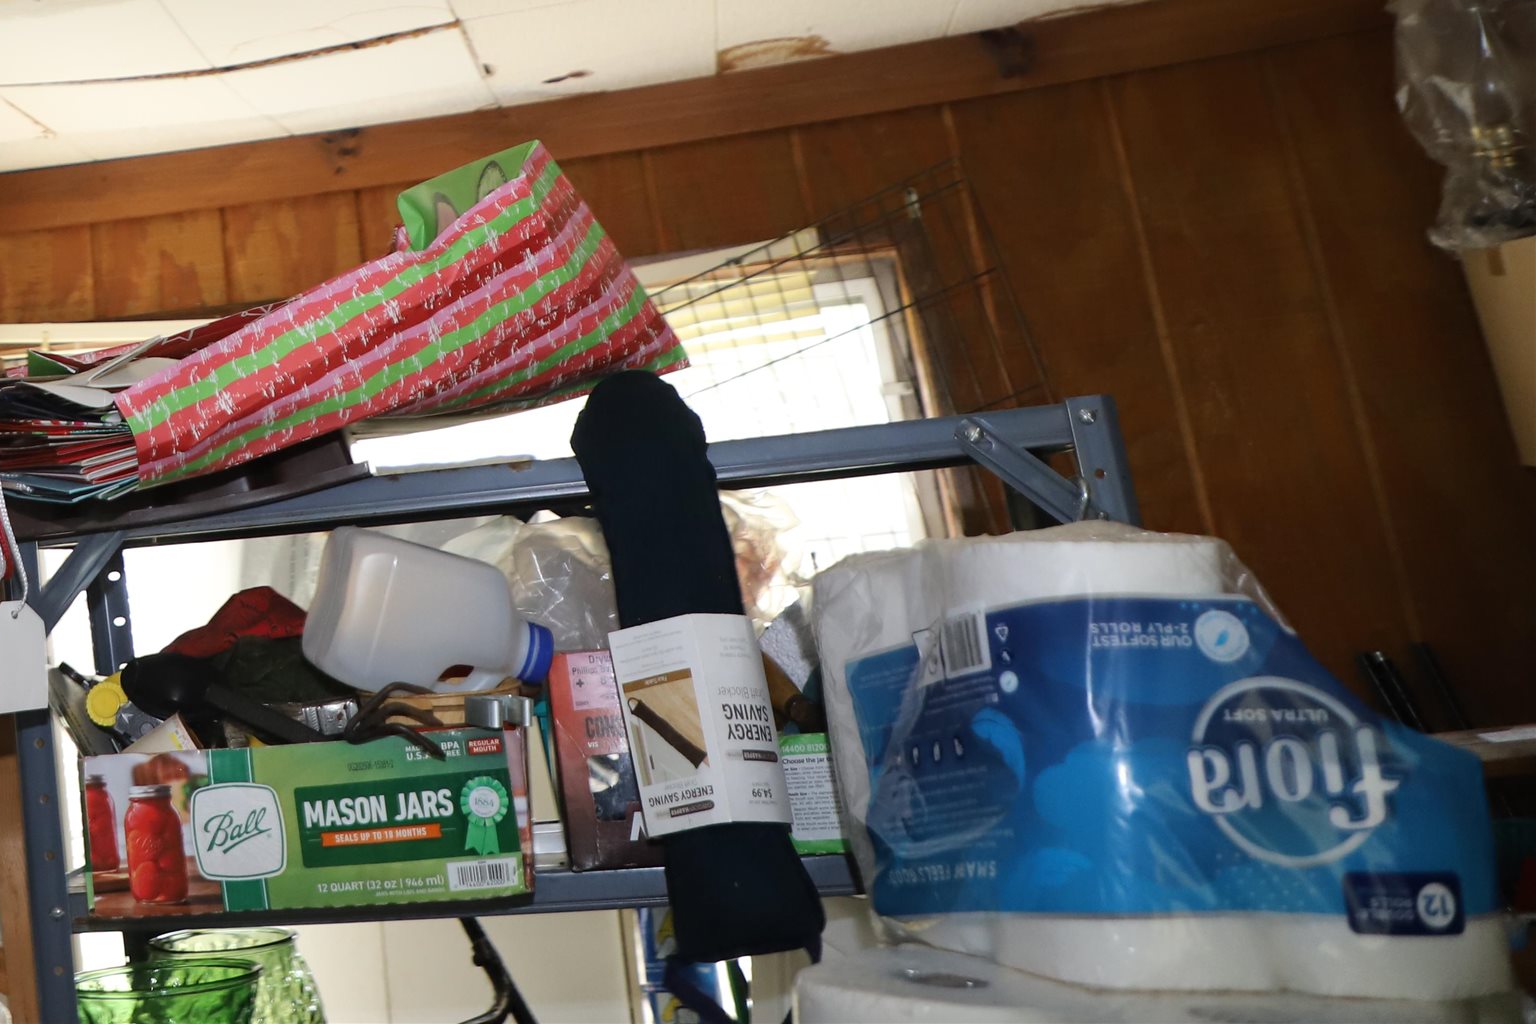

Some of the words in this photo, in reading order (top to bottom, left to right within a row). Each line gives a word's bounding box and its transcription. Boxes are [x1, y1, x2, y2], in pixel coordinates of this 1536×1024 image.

[1089, 622, 1141, 634] ROLLS
[1147, 622, 1188, 634] 2-PLY
[1092, 634, 1158, 647] SOFTEST
[1162, 634, 1193, 647] OUR
[716, 686, 750, 699] Blocker
[722, 703, 769, 721] SAVING
[1222, 708, 1267, 721] SOFT
[1271, 707, 1330, 722] ULTRA
[727, 723, 773, 742] ENERGY
[440, 741, 460, 751] BPA
[468, 738, 500, 747] REGULAR
[473, 745, 497, 753] MOUTH
[1186, 726, 1401, 830] fiora
[680, 785, 714, 798] ENERGY
[751, 787, 773, 798] $4.99
[648, 791, 680, 807] SAVING
[303, 793, 388, 829] MASON
[394, 788, 454, 820] JARS
[203, 806, 272, 855] Ball
[334, 832, 359, 843] SEALS
[360, 831, 370, 841] UP
[373, 831, 382, 840] TO
[395, 826, 427, 838] MONTHS
[317, 883, 328, 893] 12
[330, 880, 365, 892] QUART
[366, 878, 383, 891] (32
[383, 879, 398, 889] oz
[405, 876, 424, 887] 946
[425, 874, 445, 886] ml)
[1422, 893, 1451, 918] 12
